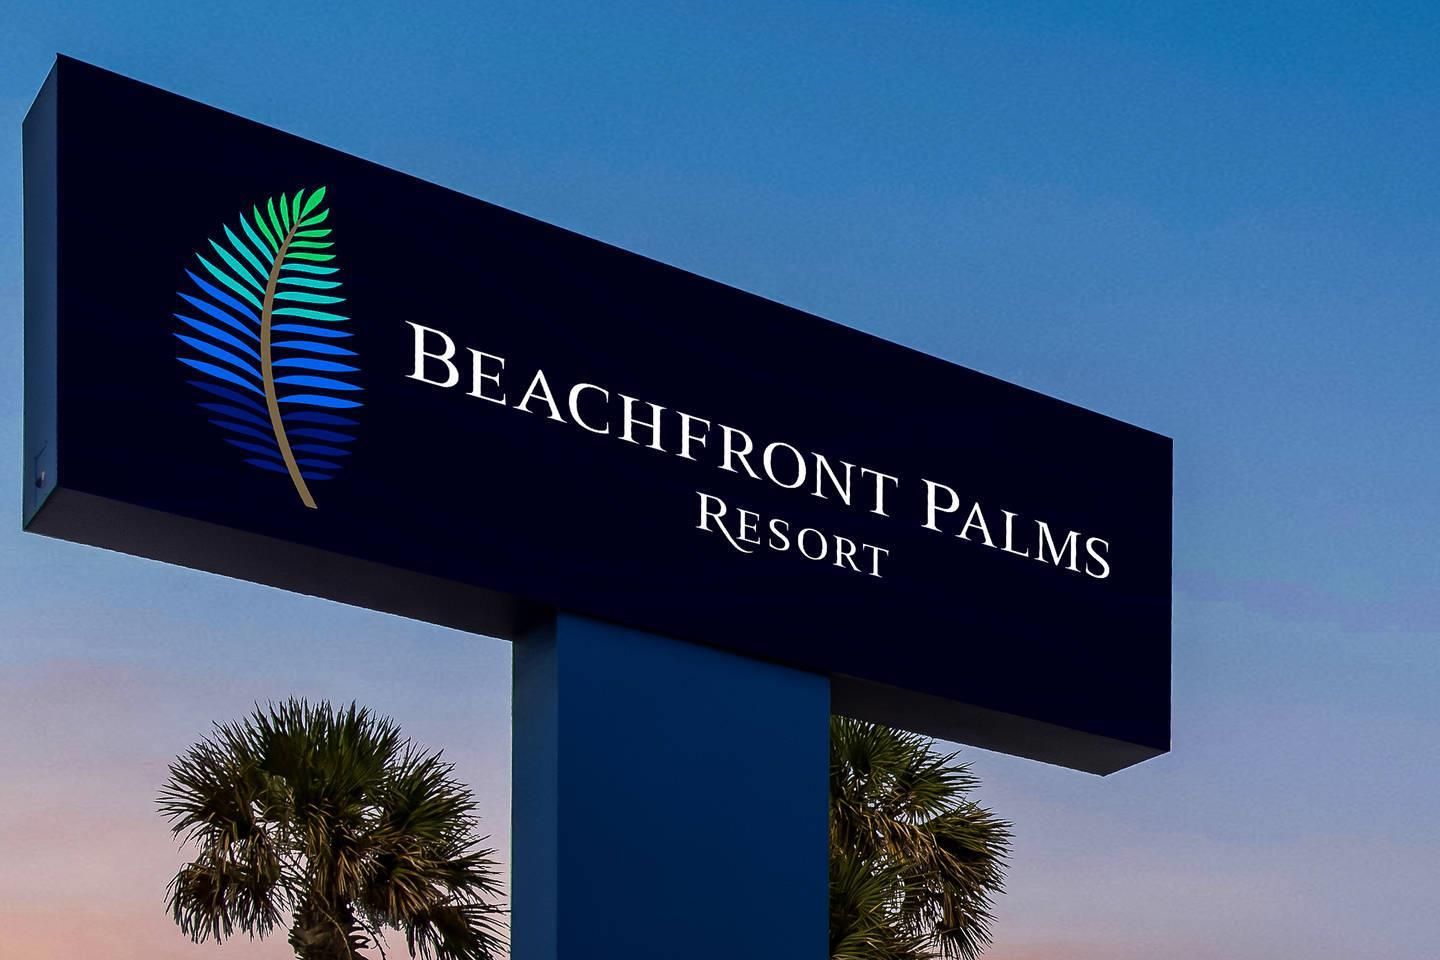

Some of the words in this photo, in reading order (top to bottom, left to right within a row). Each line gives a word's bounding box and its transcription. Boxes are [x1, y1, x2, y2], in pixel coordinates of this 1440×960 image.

[404, 320, 897, 518] BEACHFRONT
[921, 478, 1110, 579] PALMS
[695, 491, 890, 578] RESORT
